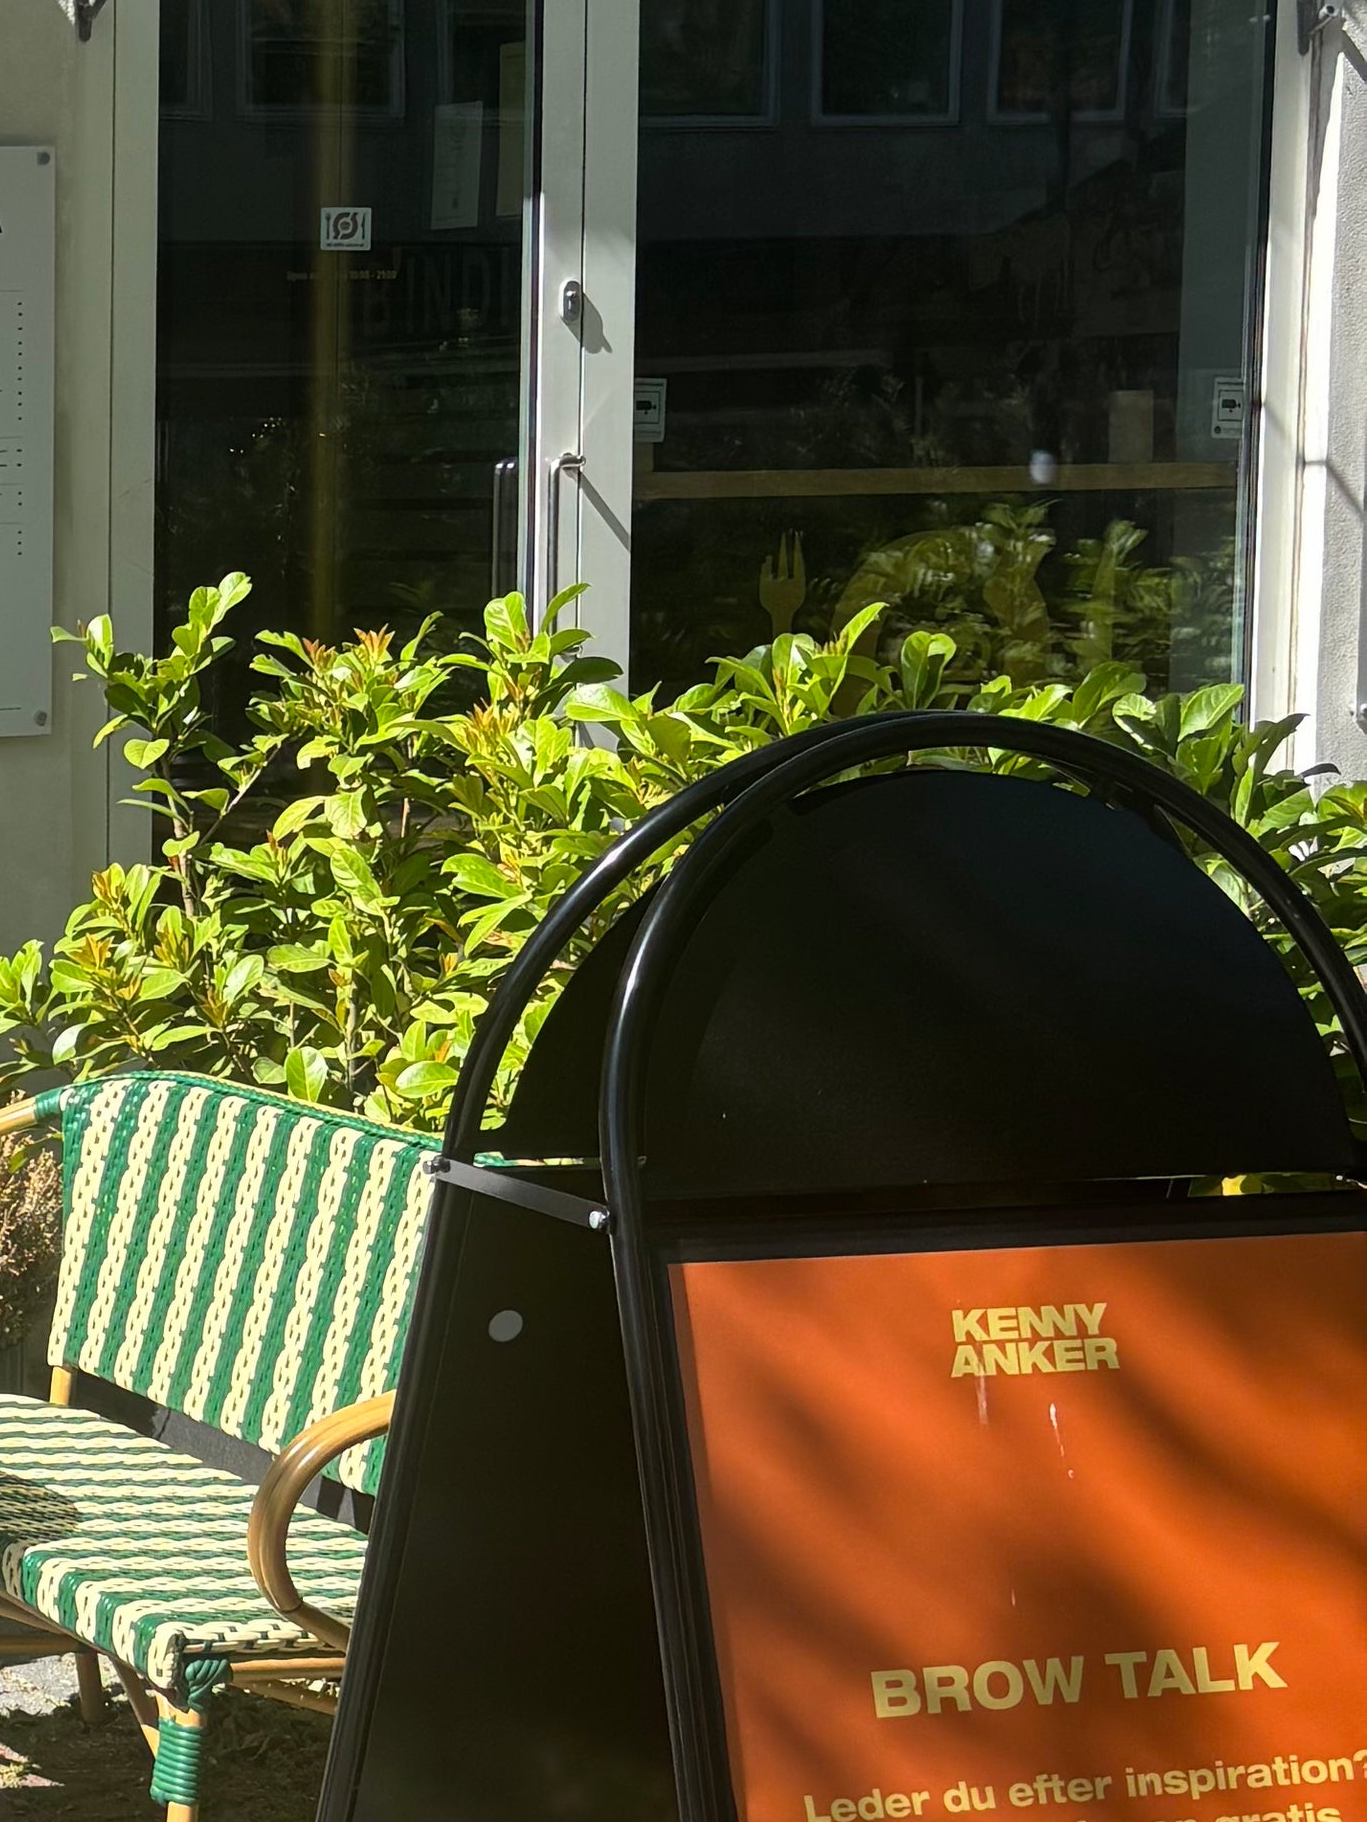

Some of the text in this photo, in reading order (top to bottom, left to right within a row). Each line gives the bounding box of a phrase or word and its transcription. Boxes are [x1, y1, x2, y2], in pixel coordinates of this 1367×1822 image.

[950, 1302, 1109, 1343] KENNY
[950, 1337, 1120, 1378] ANKER
[870, 1641, 1290, 1719] BROW TALK
[942, 1779, 997, 1813] du
[1007, 1771, 1113, 1808] efter
